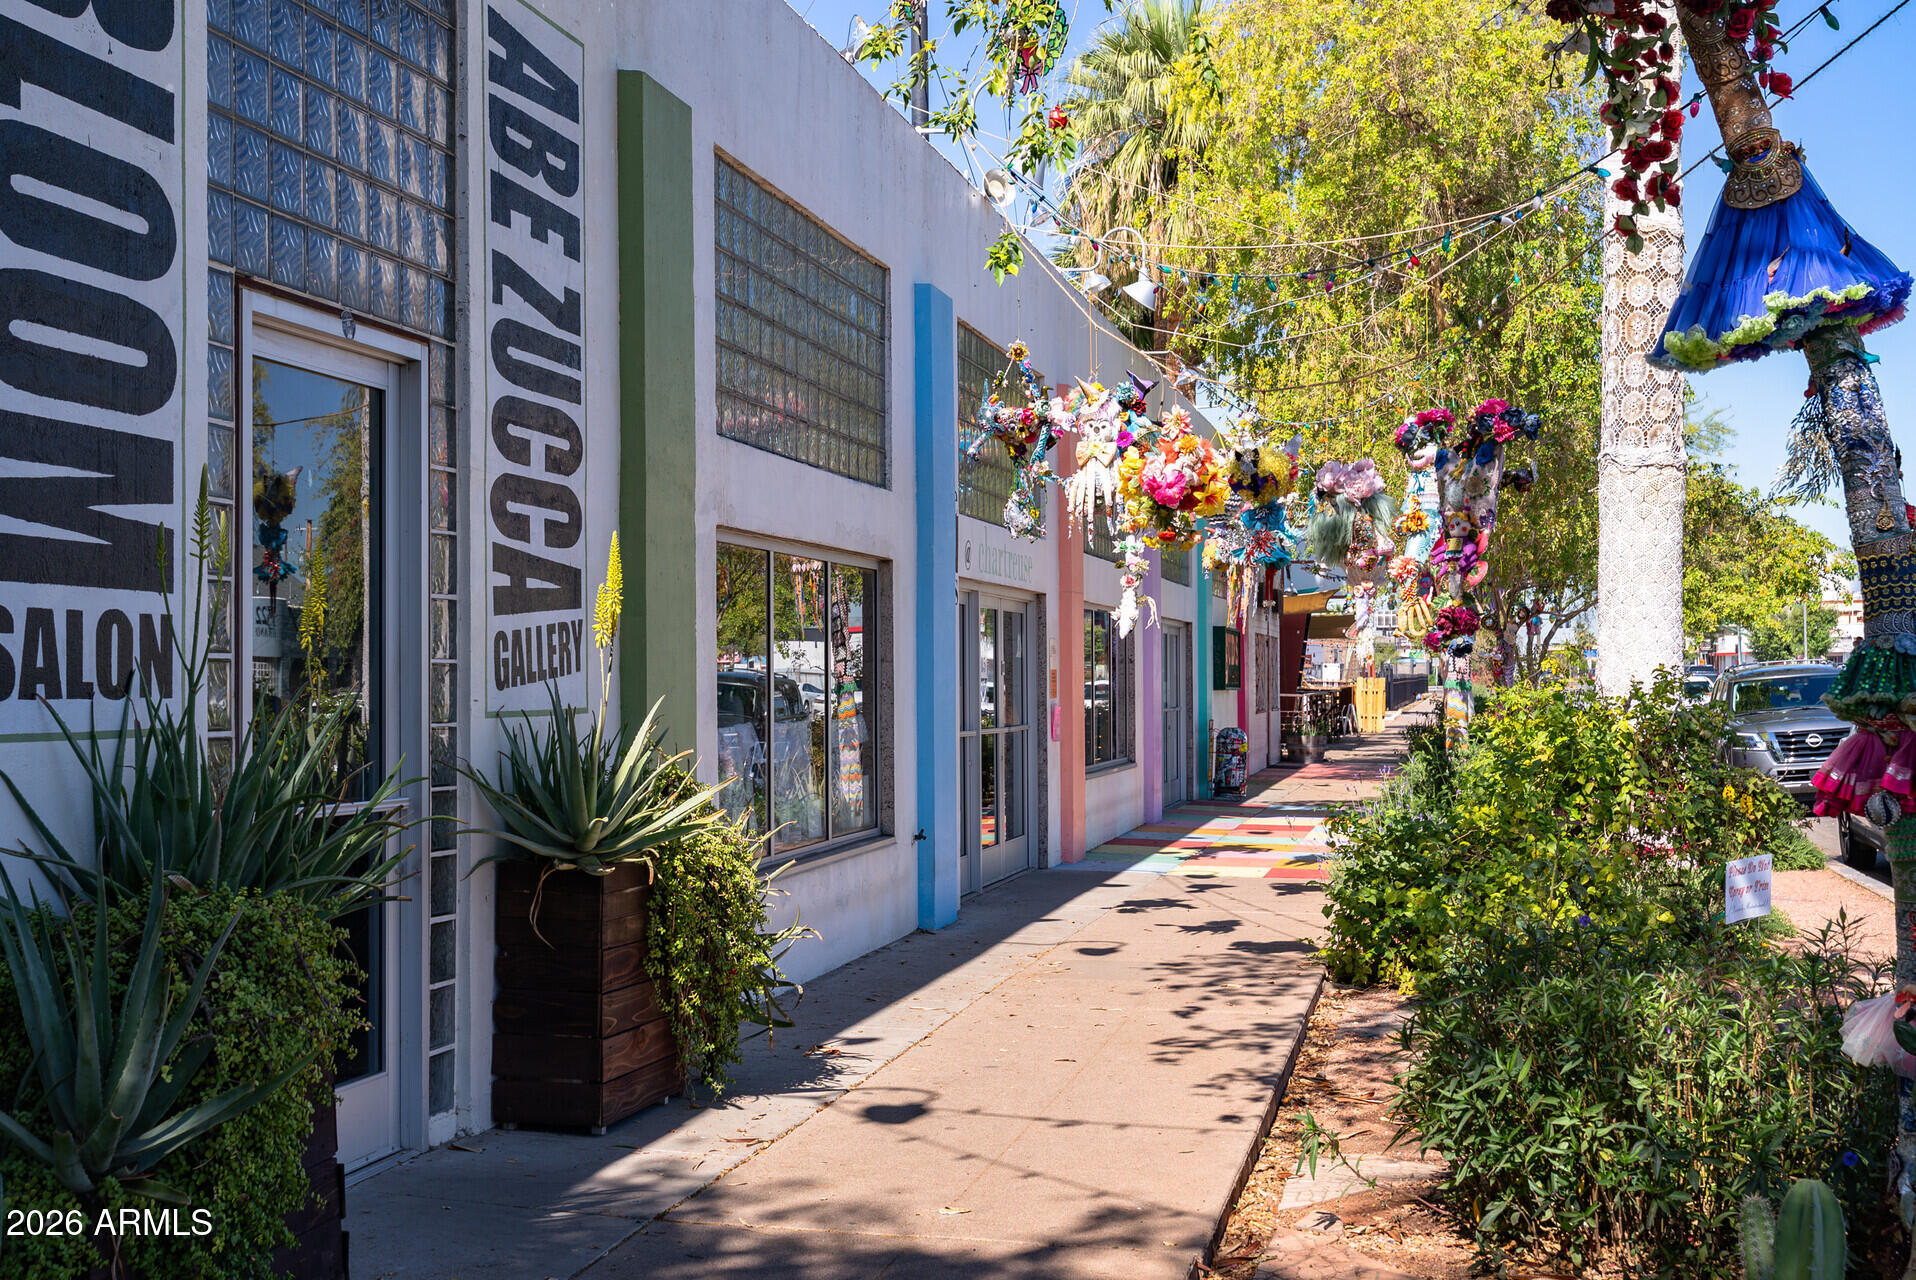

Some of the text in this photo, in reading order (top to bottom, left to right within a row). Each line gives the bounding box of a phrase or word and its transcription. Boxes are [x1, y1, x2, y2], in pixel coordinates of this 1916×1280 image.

[488, 6, 584, 616] ABEZUCCA
[979, 526, 1032, 583] chartreuse
[493, 619, 583, 692] GALLERY
